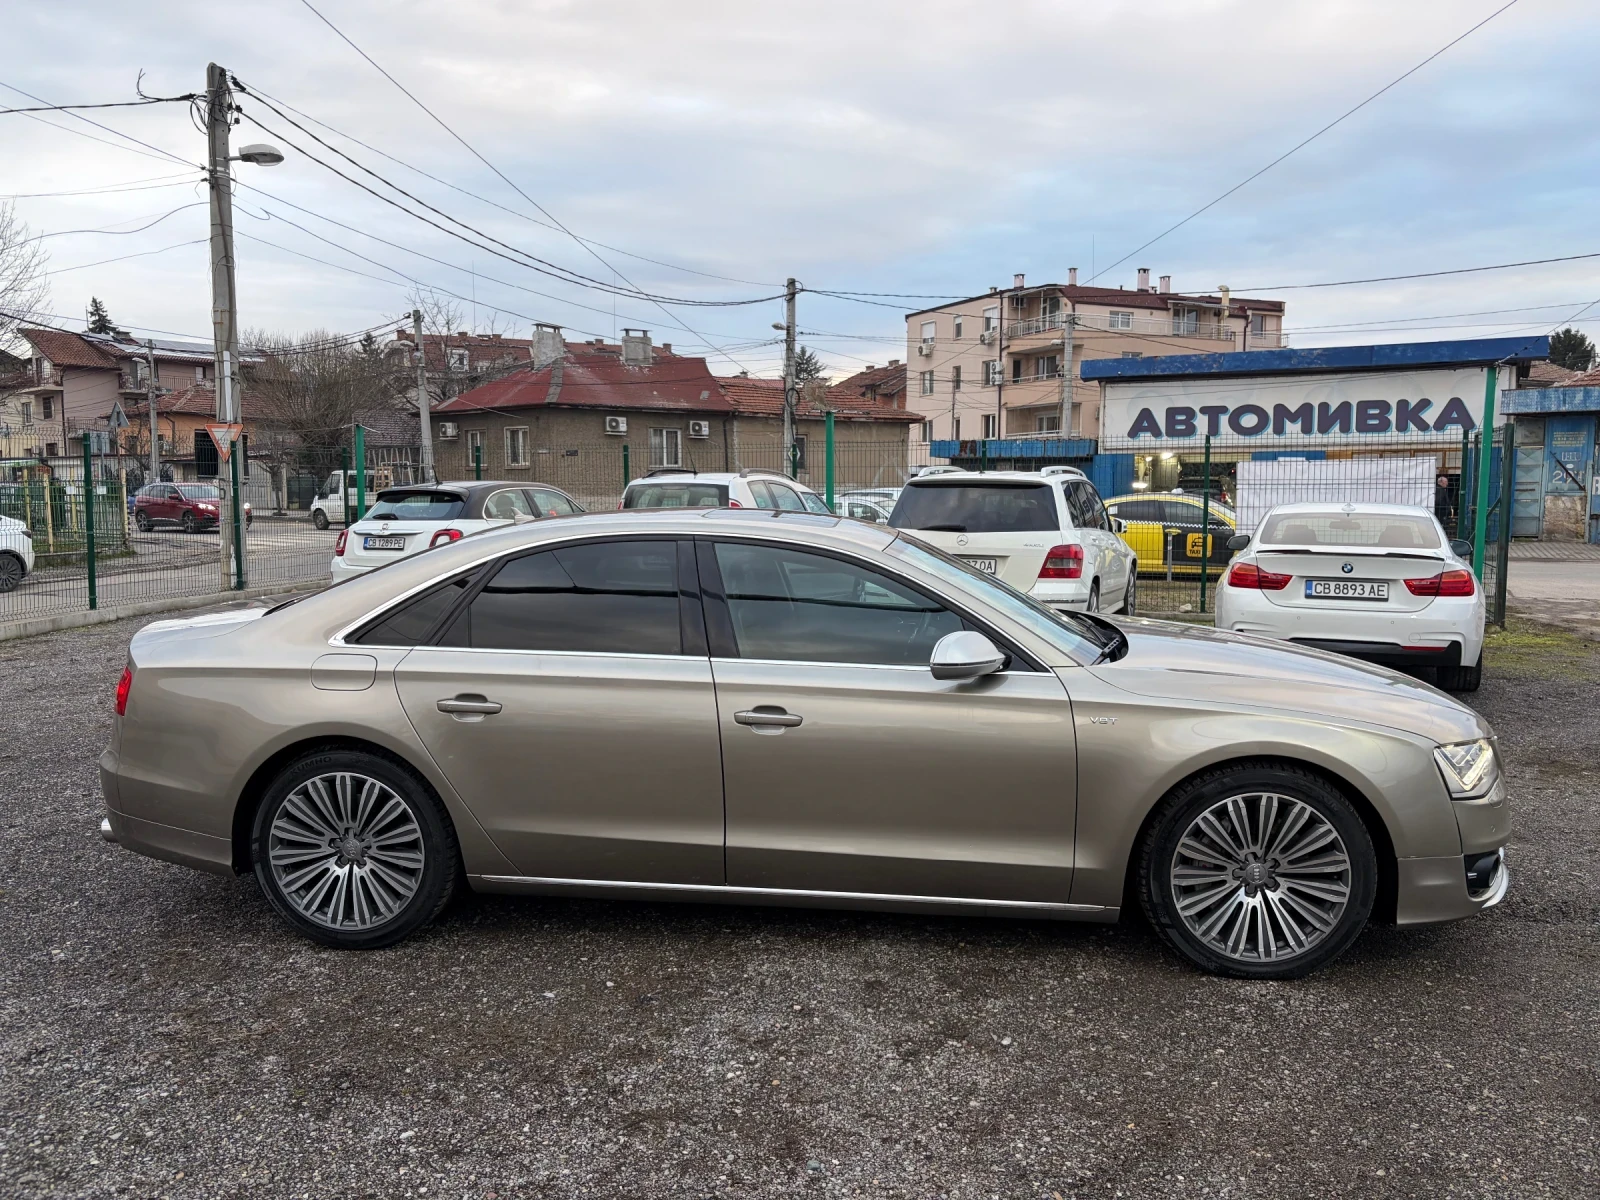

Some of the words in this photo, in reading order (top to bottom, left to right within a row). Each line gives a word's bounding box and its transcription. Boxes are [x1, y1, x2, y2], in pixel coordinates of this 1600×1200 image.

[1127, 397, 1476, 439] АВТОМИВКА
[378, 539, 393, 547] 1289
[394, 540, 402, 548] PE
[1314, 583, 1331, 594] CB
[1333, 583, 1365, 596] 8893
[1368, 584, 1386, 596] AE
[1090, 716, 1118, 725] V8T
[290, 756, 332, 776] KUMHO
